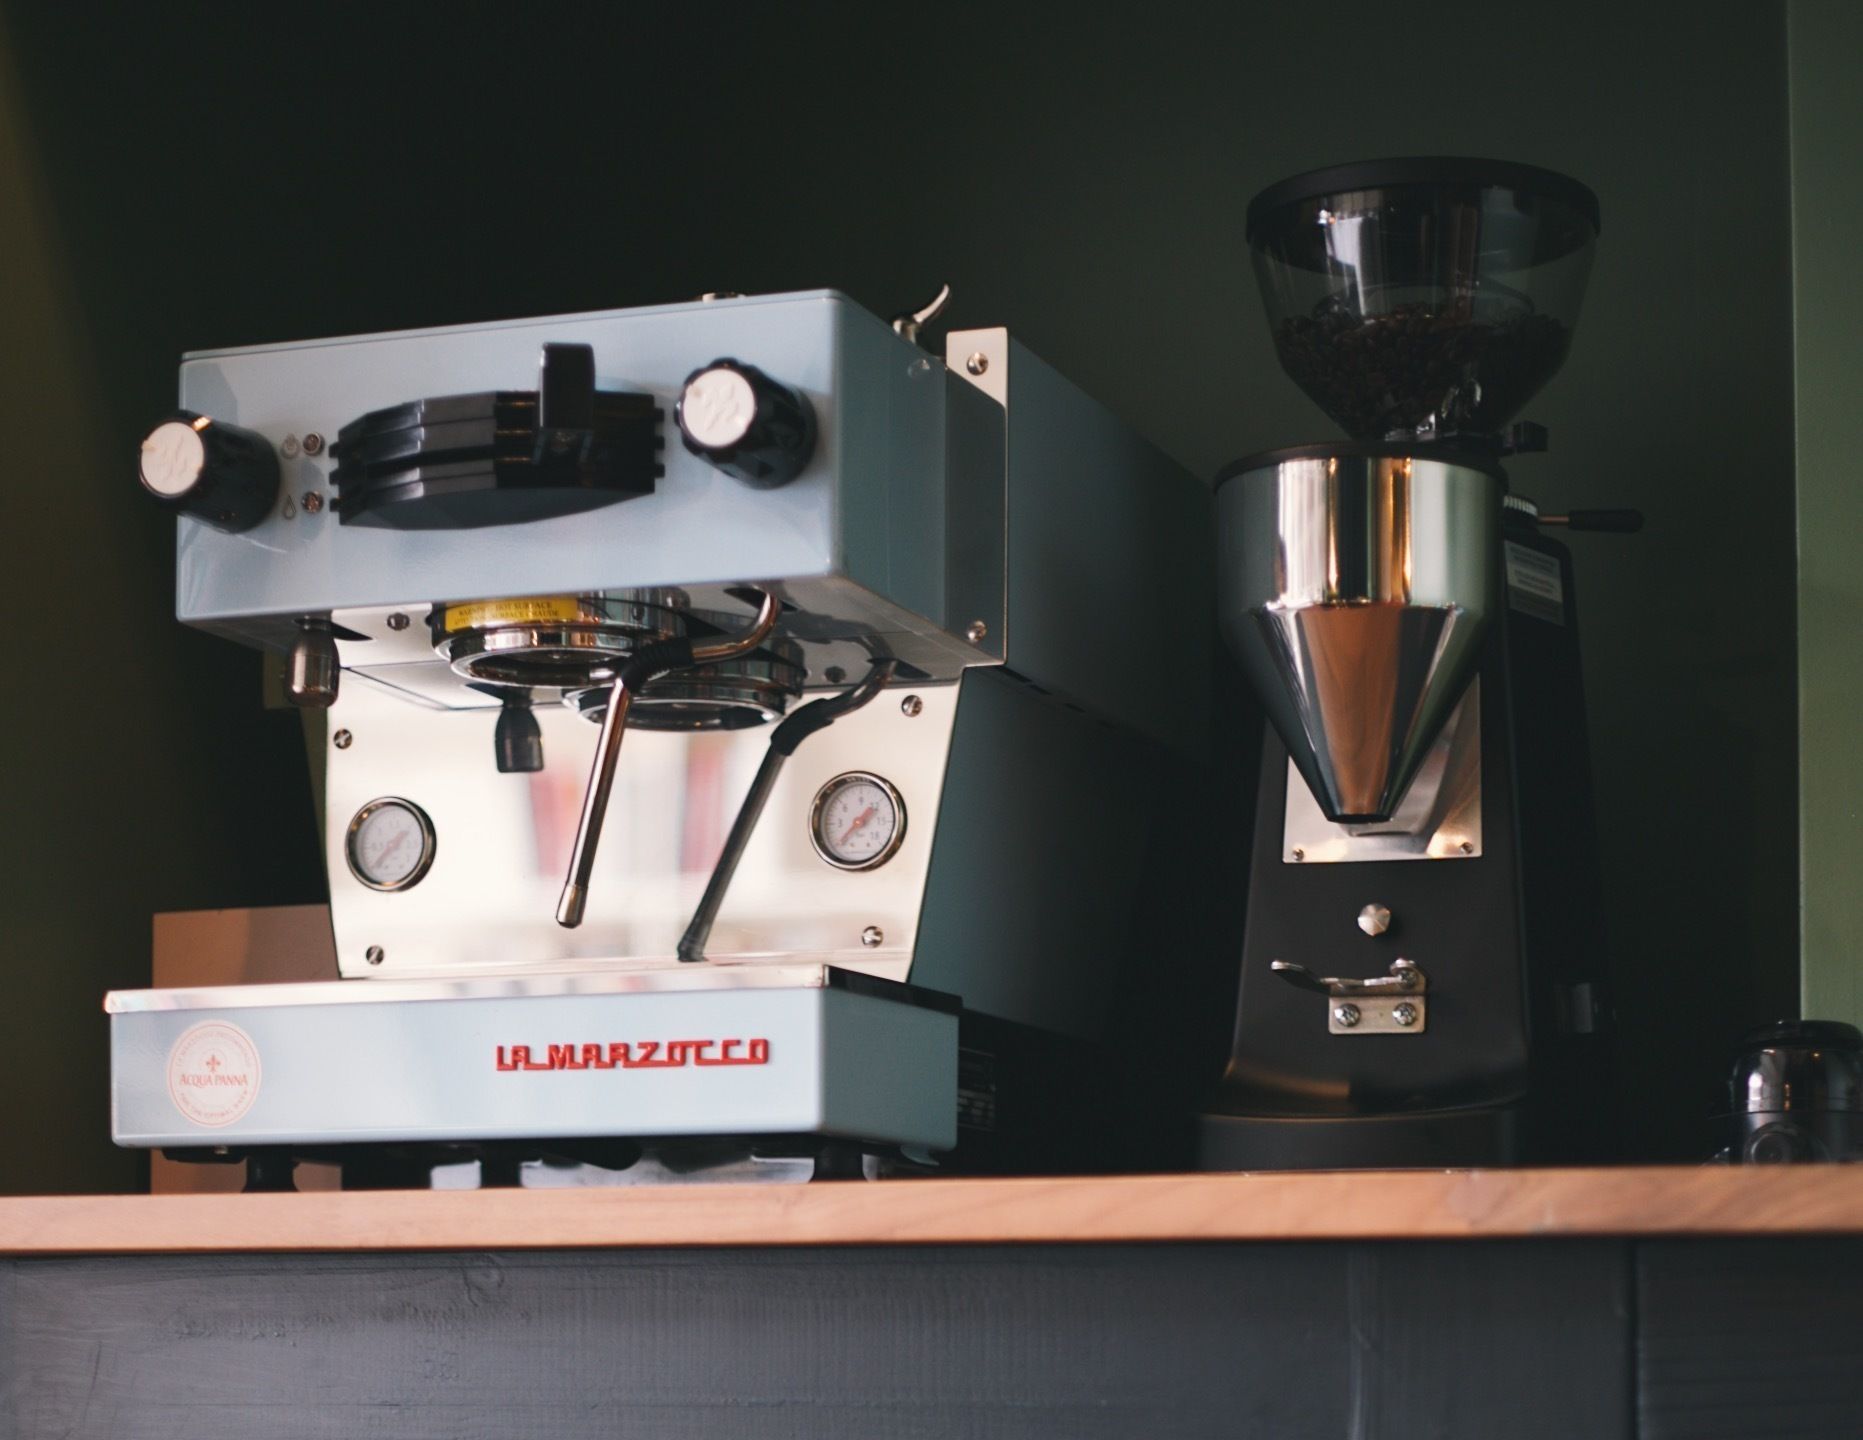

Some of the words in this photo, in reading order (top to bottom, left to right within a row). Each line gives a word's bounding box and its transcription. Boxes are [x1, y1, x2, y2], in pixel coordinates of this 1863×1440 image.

[496, 1046, 532, 1072] LA
[548, 1038, 769, 1071] MARZOCCO
[179, 1074, 213, 1088] ACQUA
[214, 1073, 248, 1087] PANNA
